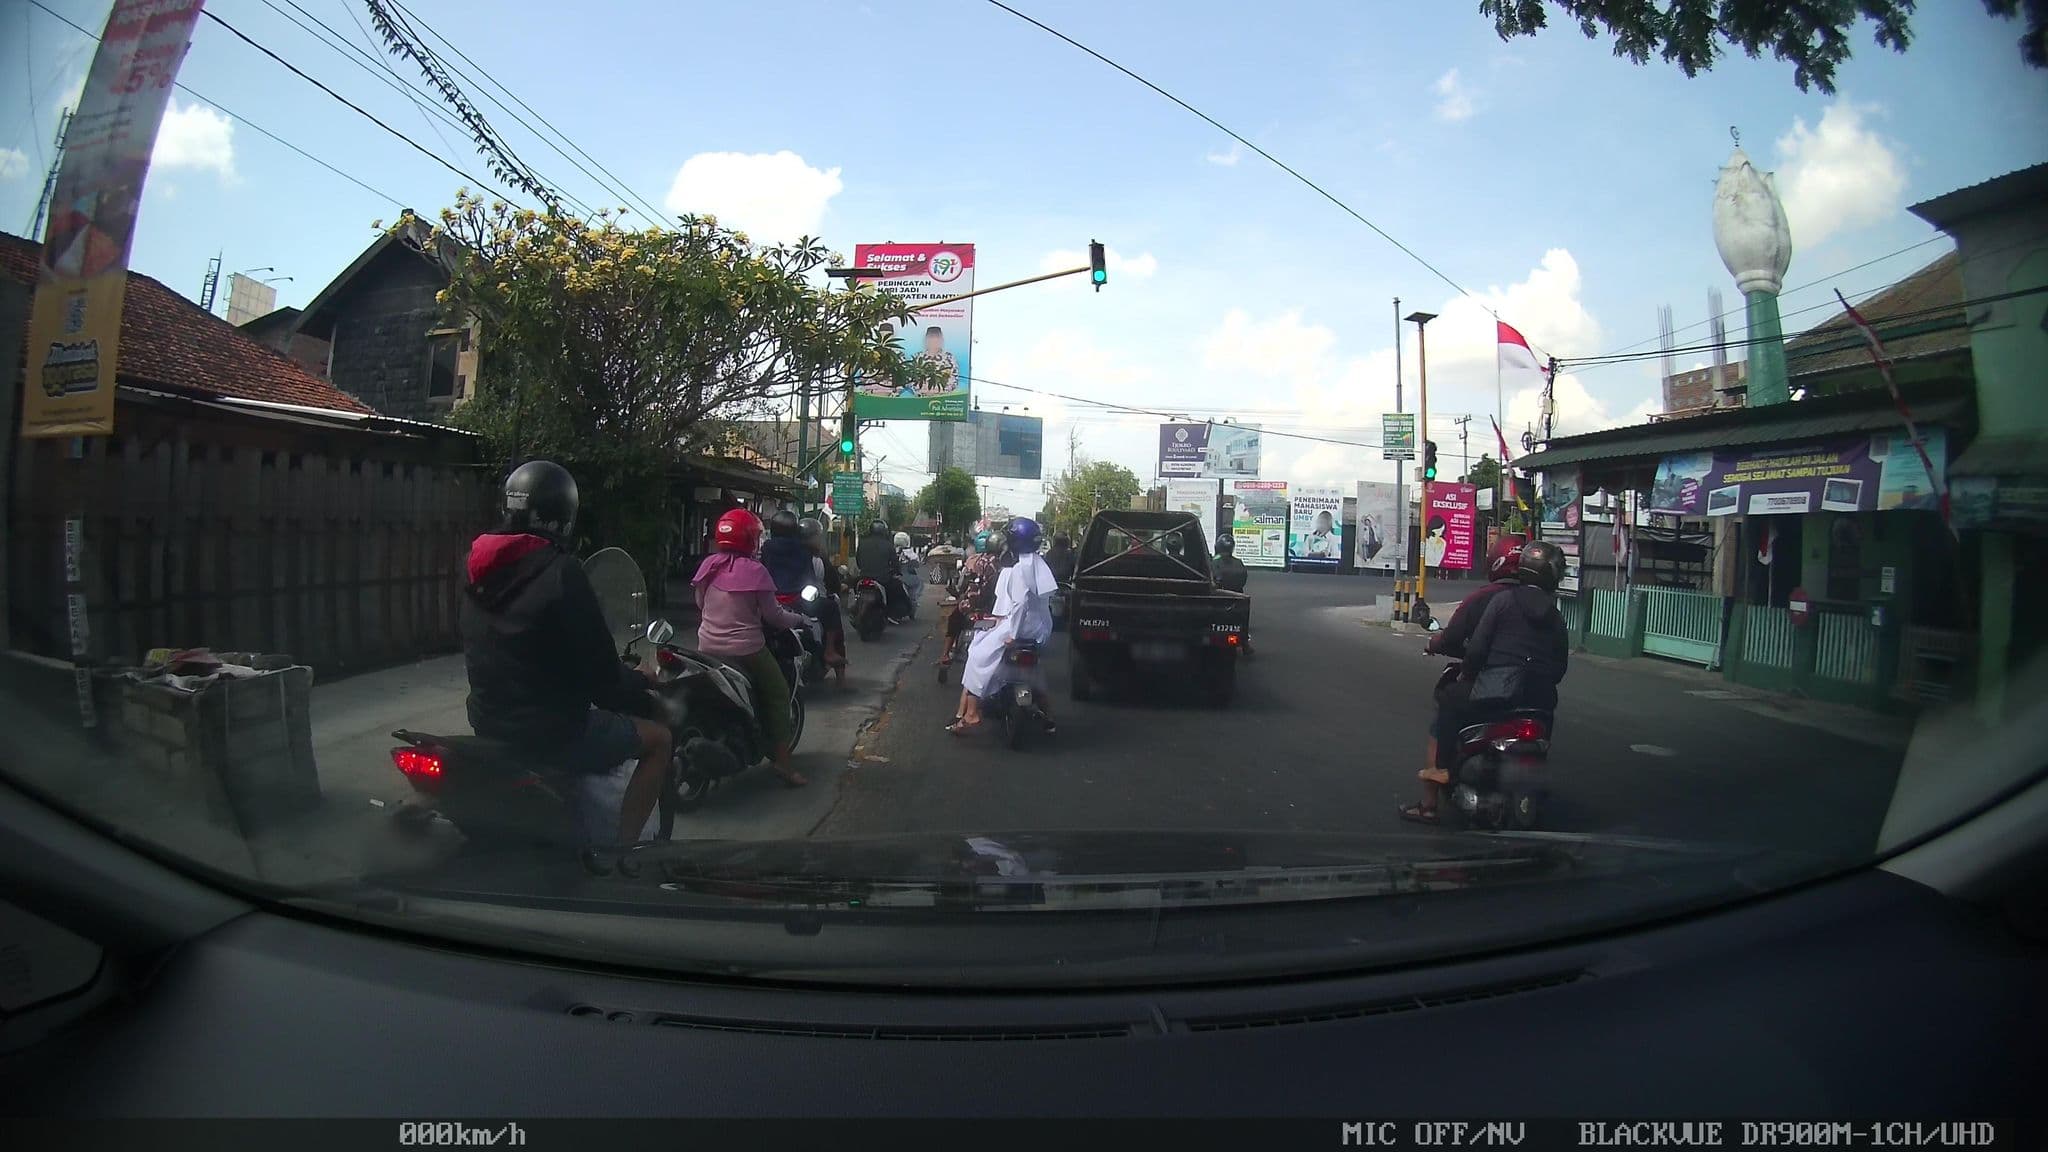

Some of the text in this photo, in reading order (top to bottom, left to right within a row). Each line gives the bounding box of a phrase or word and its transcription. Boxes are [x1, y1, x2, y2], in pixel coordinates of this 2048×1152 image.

[866, 253, 927, 262] Selamat &
[1752, 470, 1785, 481] SELAMAT
[1785, 466, 1816, 478] SAMPAI
[1294, 496, 1340, 504] PENERIMAAN
[1433, 501, 1468, 510] EKSKLUSIF
[1254, 513, 1284, 524] salman
